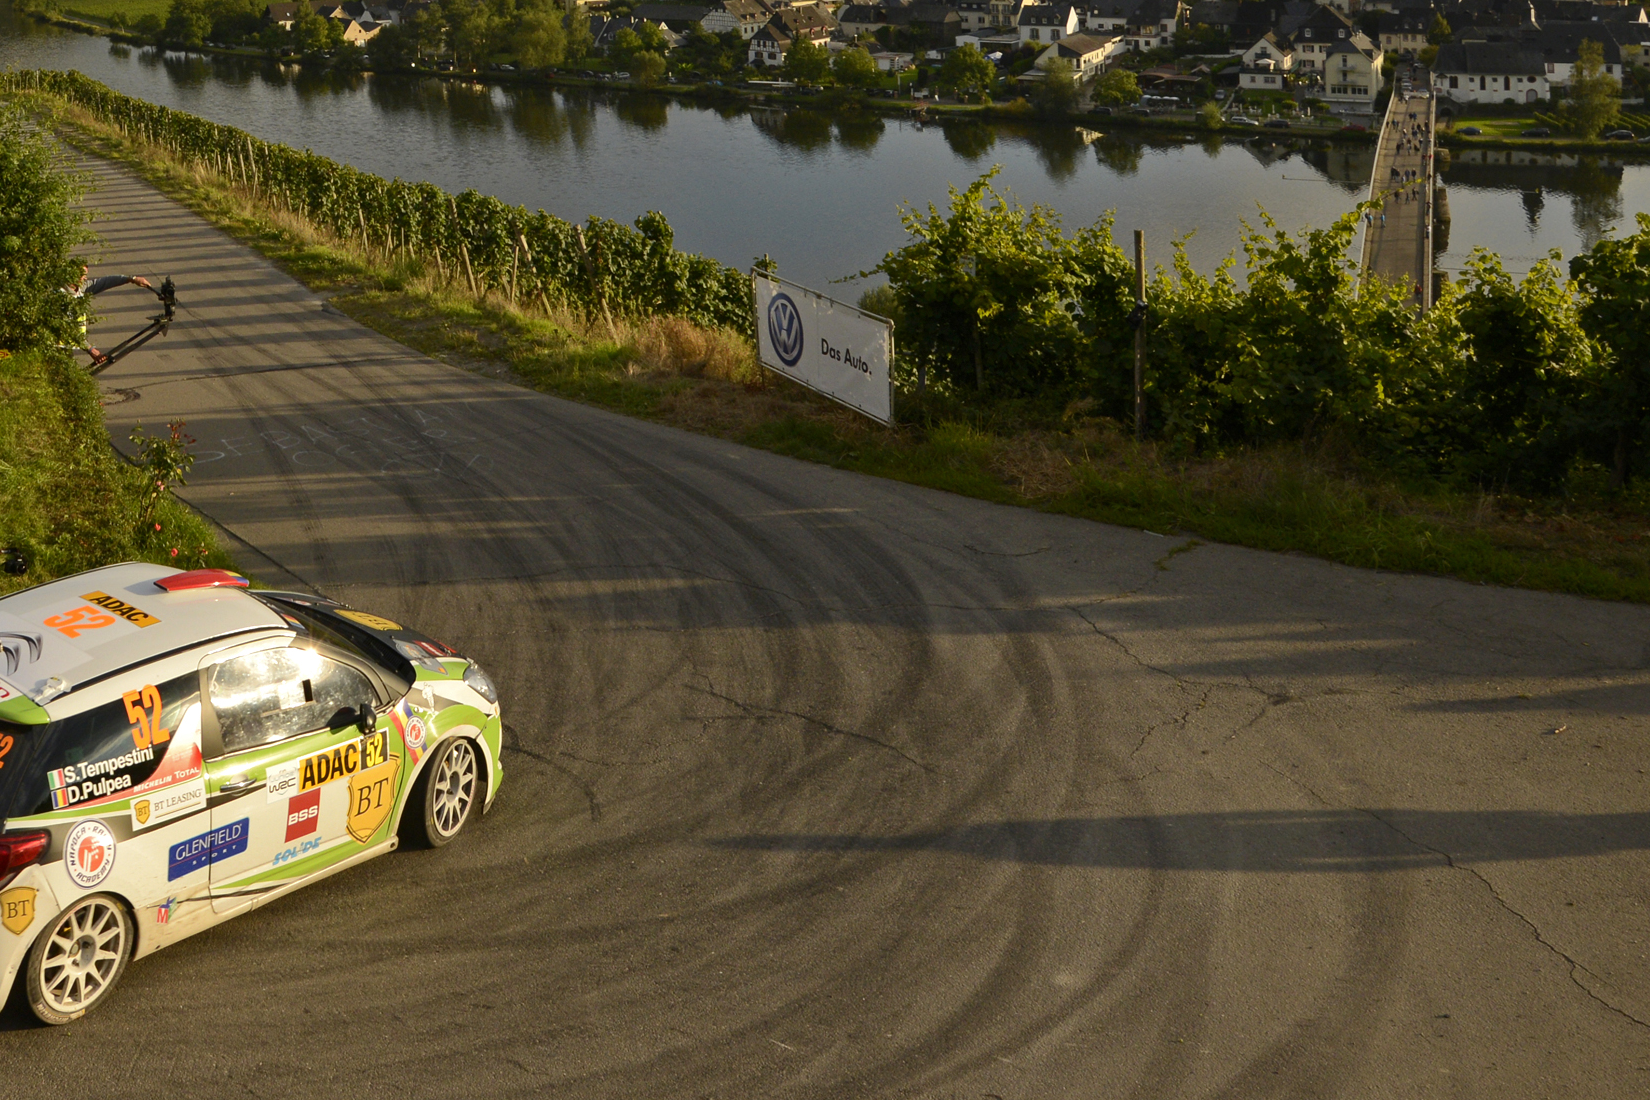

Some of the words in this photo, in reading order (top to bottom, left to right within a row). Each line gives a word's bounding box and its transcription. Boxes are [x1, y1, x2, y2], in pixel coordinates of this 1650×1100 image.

[821, 338, 841, 361] Das
[844, 348, 872, 375] Auto.
[43, 605, 116, 639] 52
[91, 595, 149, 622] ADAC
[122, 684, 170, 750] 52
[64, 744, 154, 783] S.Tempestini
[366, 732, 384, 768] 52
[133, 775, 173, 793] MICHELIN
[174, 766, 200, 779] TOTAL
[301, 743, 358, 790] ADAC
[67, 774, 131, 803] D.Pulpea
[269, 777, 296, 794] WRC
[354, 777, 389, 818] BT
[137, 806, 148, 817] BT
[154, 801, 165, 812] BT
[166, 789, 200, 808] LEASING
[288, 805, 319, 826] BSS
[176, 823, 241, 861] GLENFIELD
[192, 845, 237, 865] SPORT
[6, 900, 30, 919] BT
